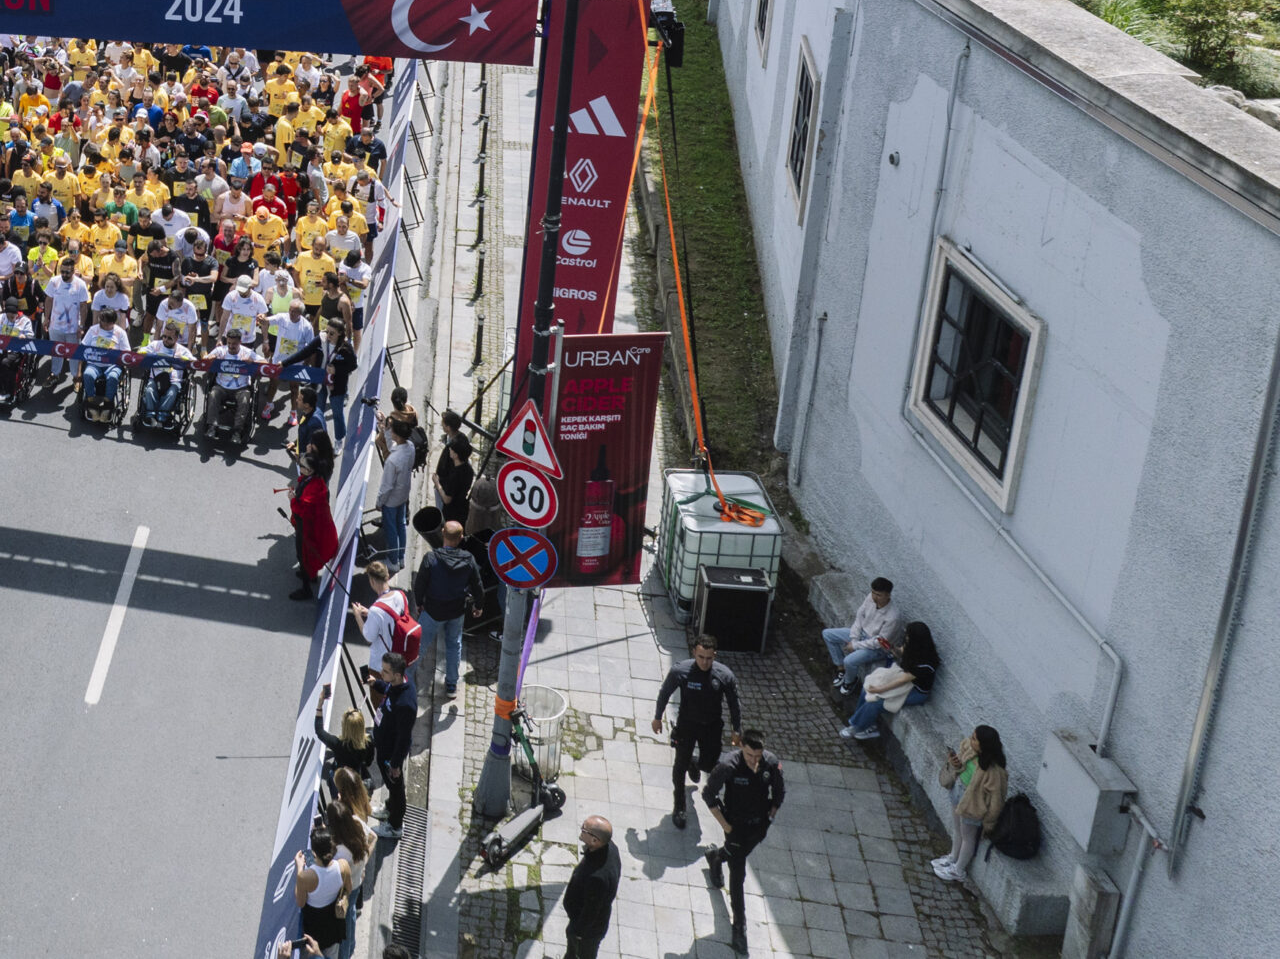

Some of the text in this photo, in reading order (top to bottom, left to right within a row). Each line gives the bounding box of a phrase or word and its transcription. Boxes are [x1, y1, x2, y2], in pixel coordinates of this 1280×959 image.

[561, 197, 612, 209] ENAULT
[553, 287, 598, 301] iGROS
[564, 346, 652, 368] URBAN Care
[562, 377, 634, 395] APPLE
[561, 395, 626, 412] CIDER
[560, 414, 621, 424] KEPEK KARŞITI
[560, 423, 606, 434] SAÇ BAKIM
[560, 431, 588, 441] TONİĞİ
[509, 475, 545, 513] 30
